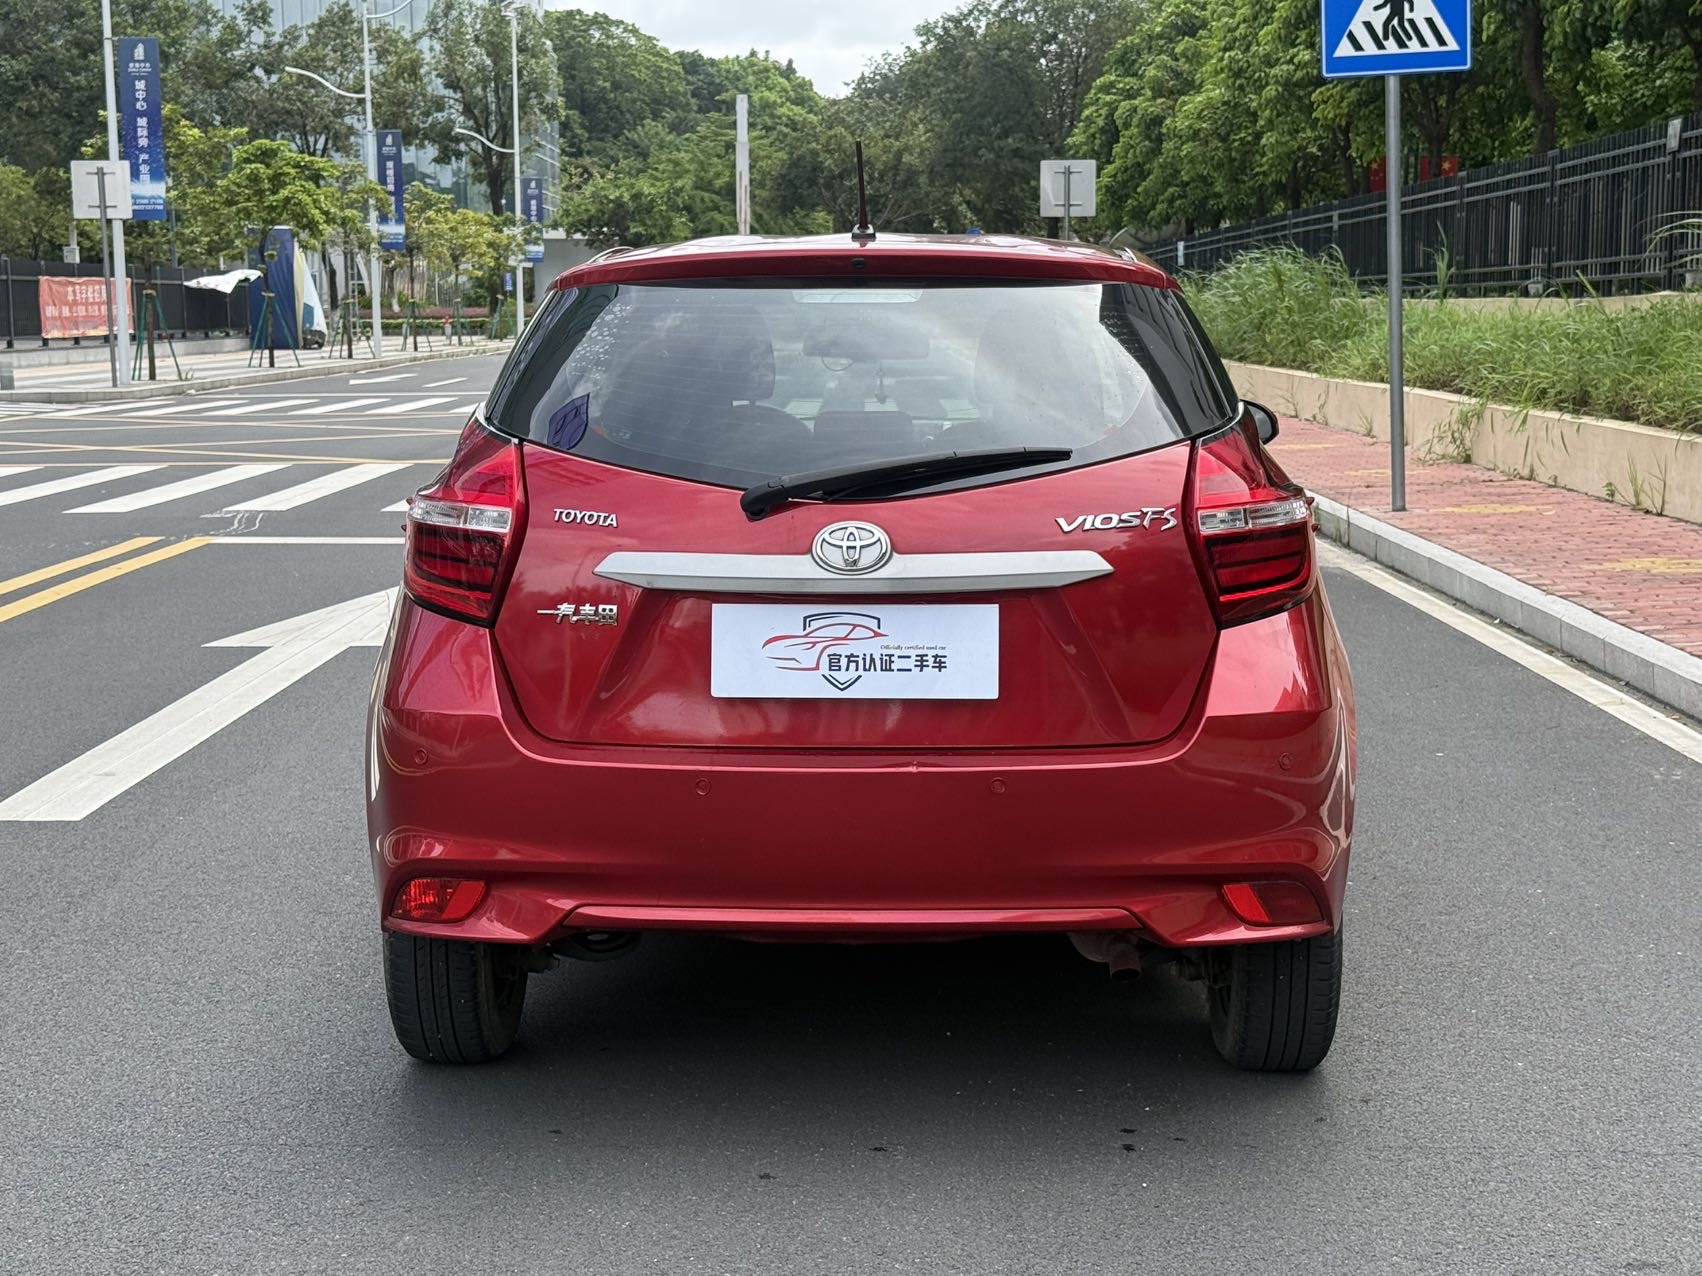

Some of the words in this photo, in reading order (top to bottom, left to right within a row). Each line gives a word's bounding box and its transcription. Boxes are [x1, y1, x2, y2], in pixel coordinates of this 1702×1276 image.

[553, 508, 618, 528] TOYOTA
[537, 602, 618, 627] 一汽丰田
[827, 653, 948, 673] 官方认证二手车
